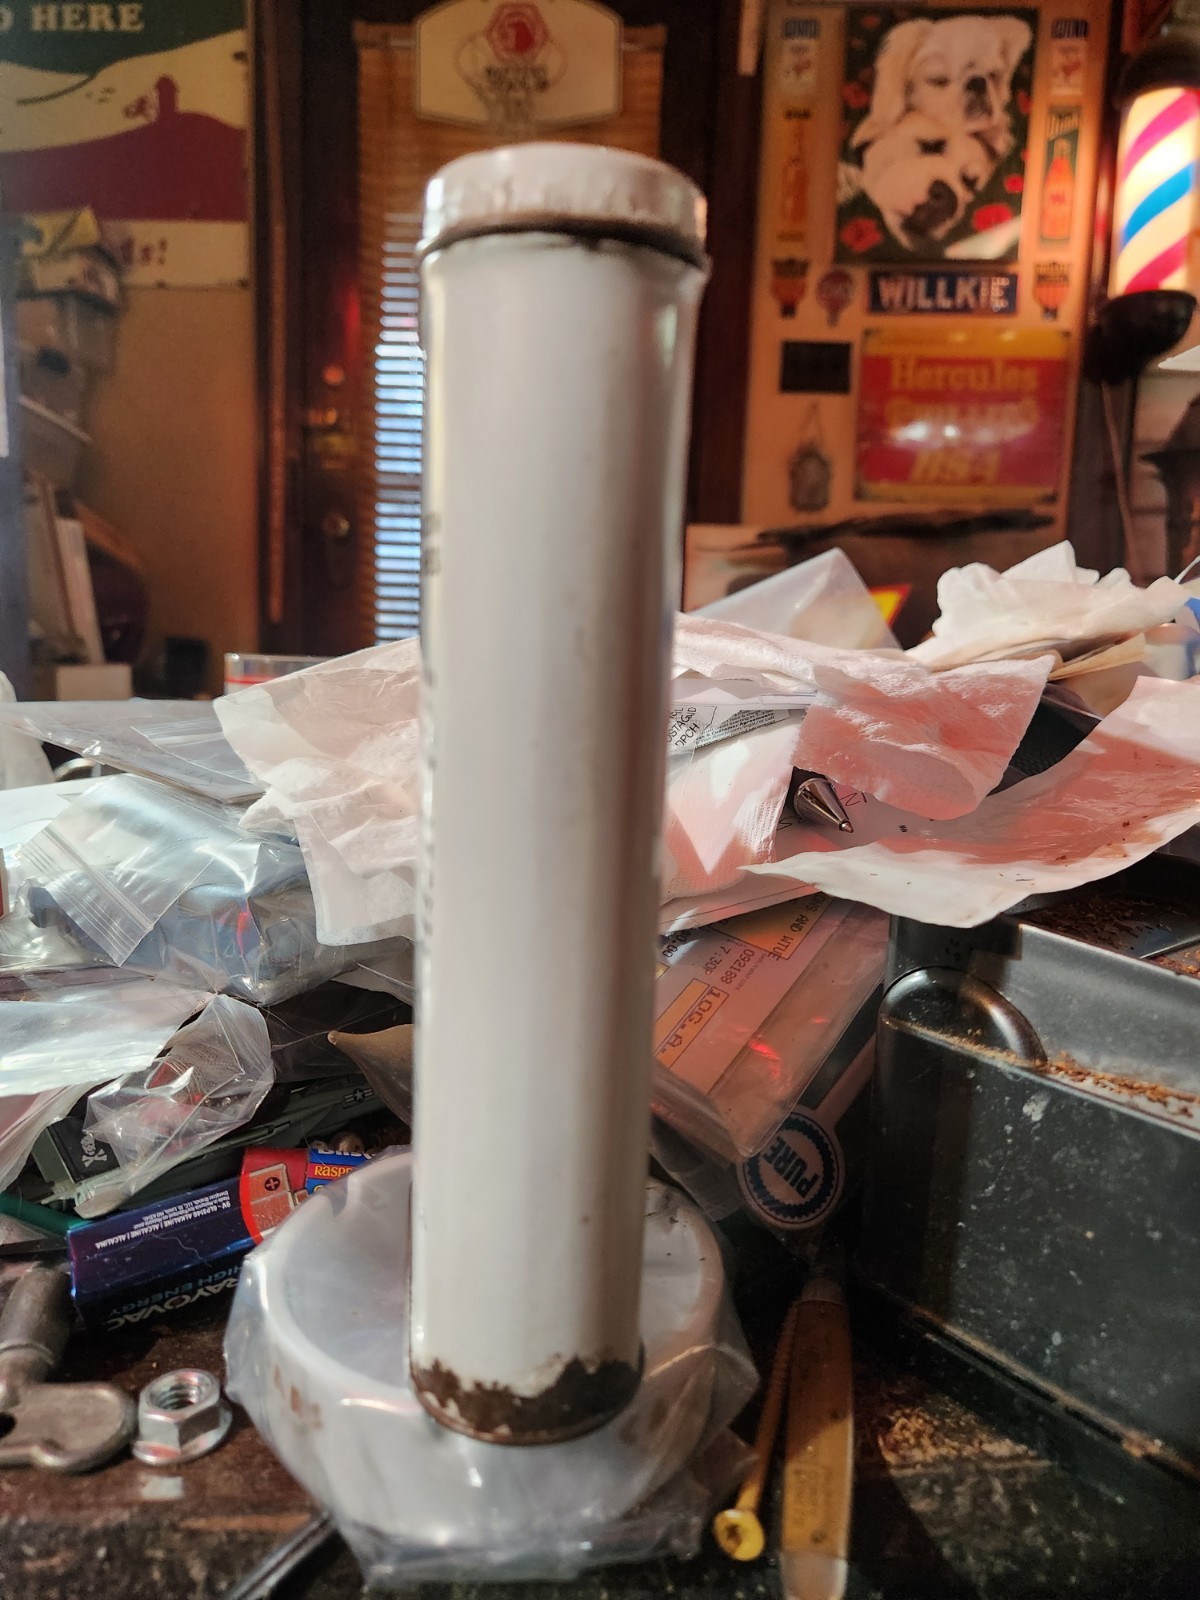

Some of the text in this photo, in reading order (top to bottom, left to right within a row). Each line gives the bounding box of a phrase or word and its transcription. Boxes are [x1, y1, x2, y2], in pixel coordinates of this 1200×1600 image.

[31, 4, 145, 31] HERE
[877, 276, 1010, 312] WILLKIE
[789, 914, 810, 933] AND
[720, 948, 755, 985] 092188
[763, 1136, 819, 1198] PURE
[221, 1201, 231, 1209] 9V
[130, 1223, 160, 1237] ALCALINE
[163, 1213, 193, 1227] ALKALINE
[94, 1234, 127, 1249] ALCALINA
[105, 1277, 240, 1331] RAYOVAC
[109, 1282, 193, 1319] ENERGY
